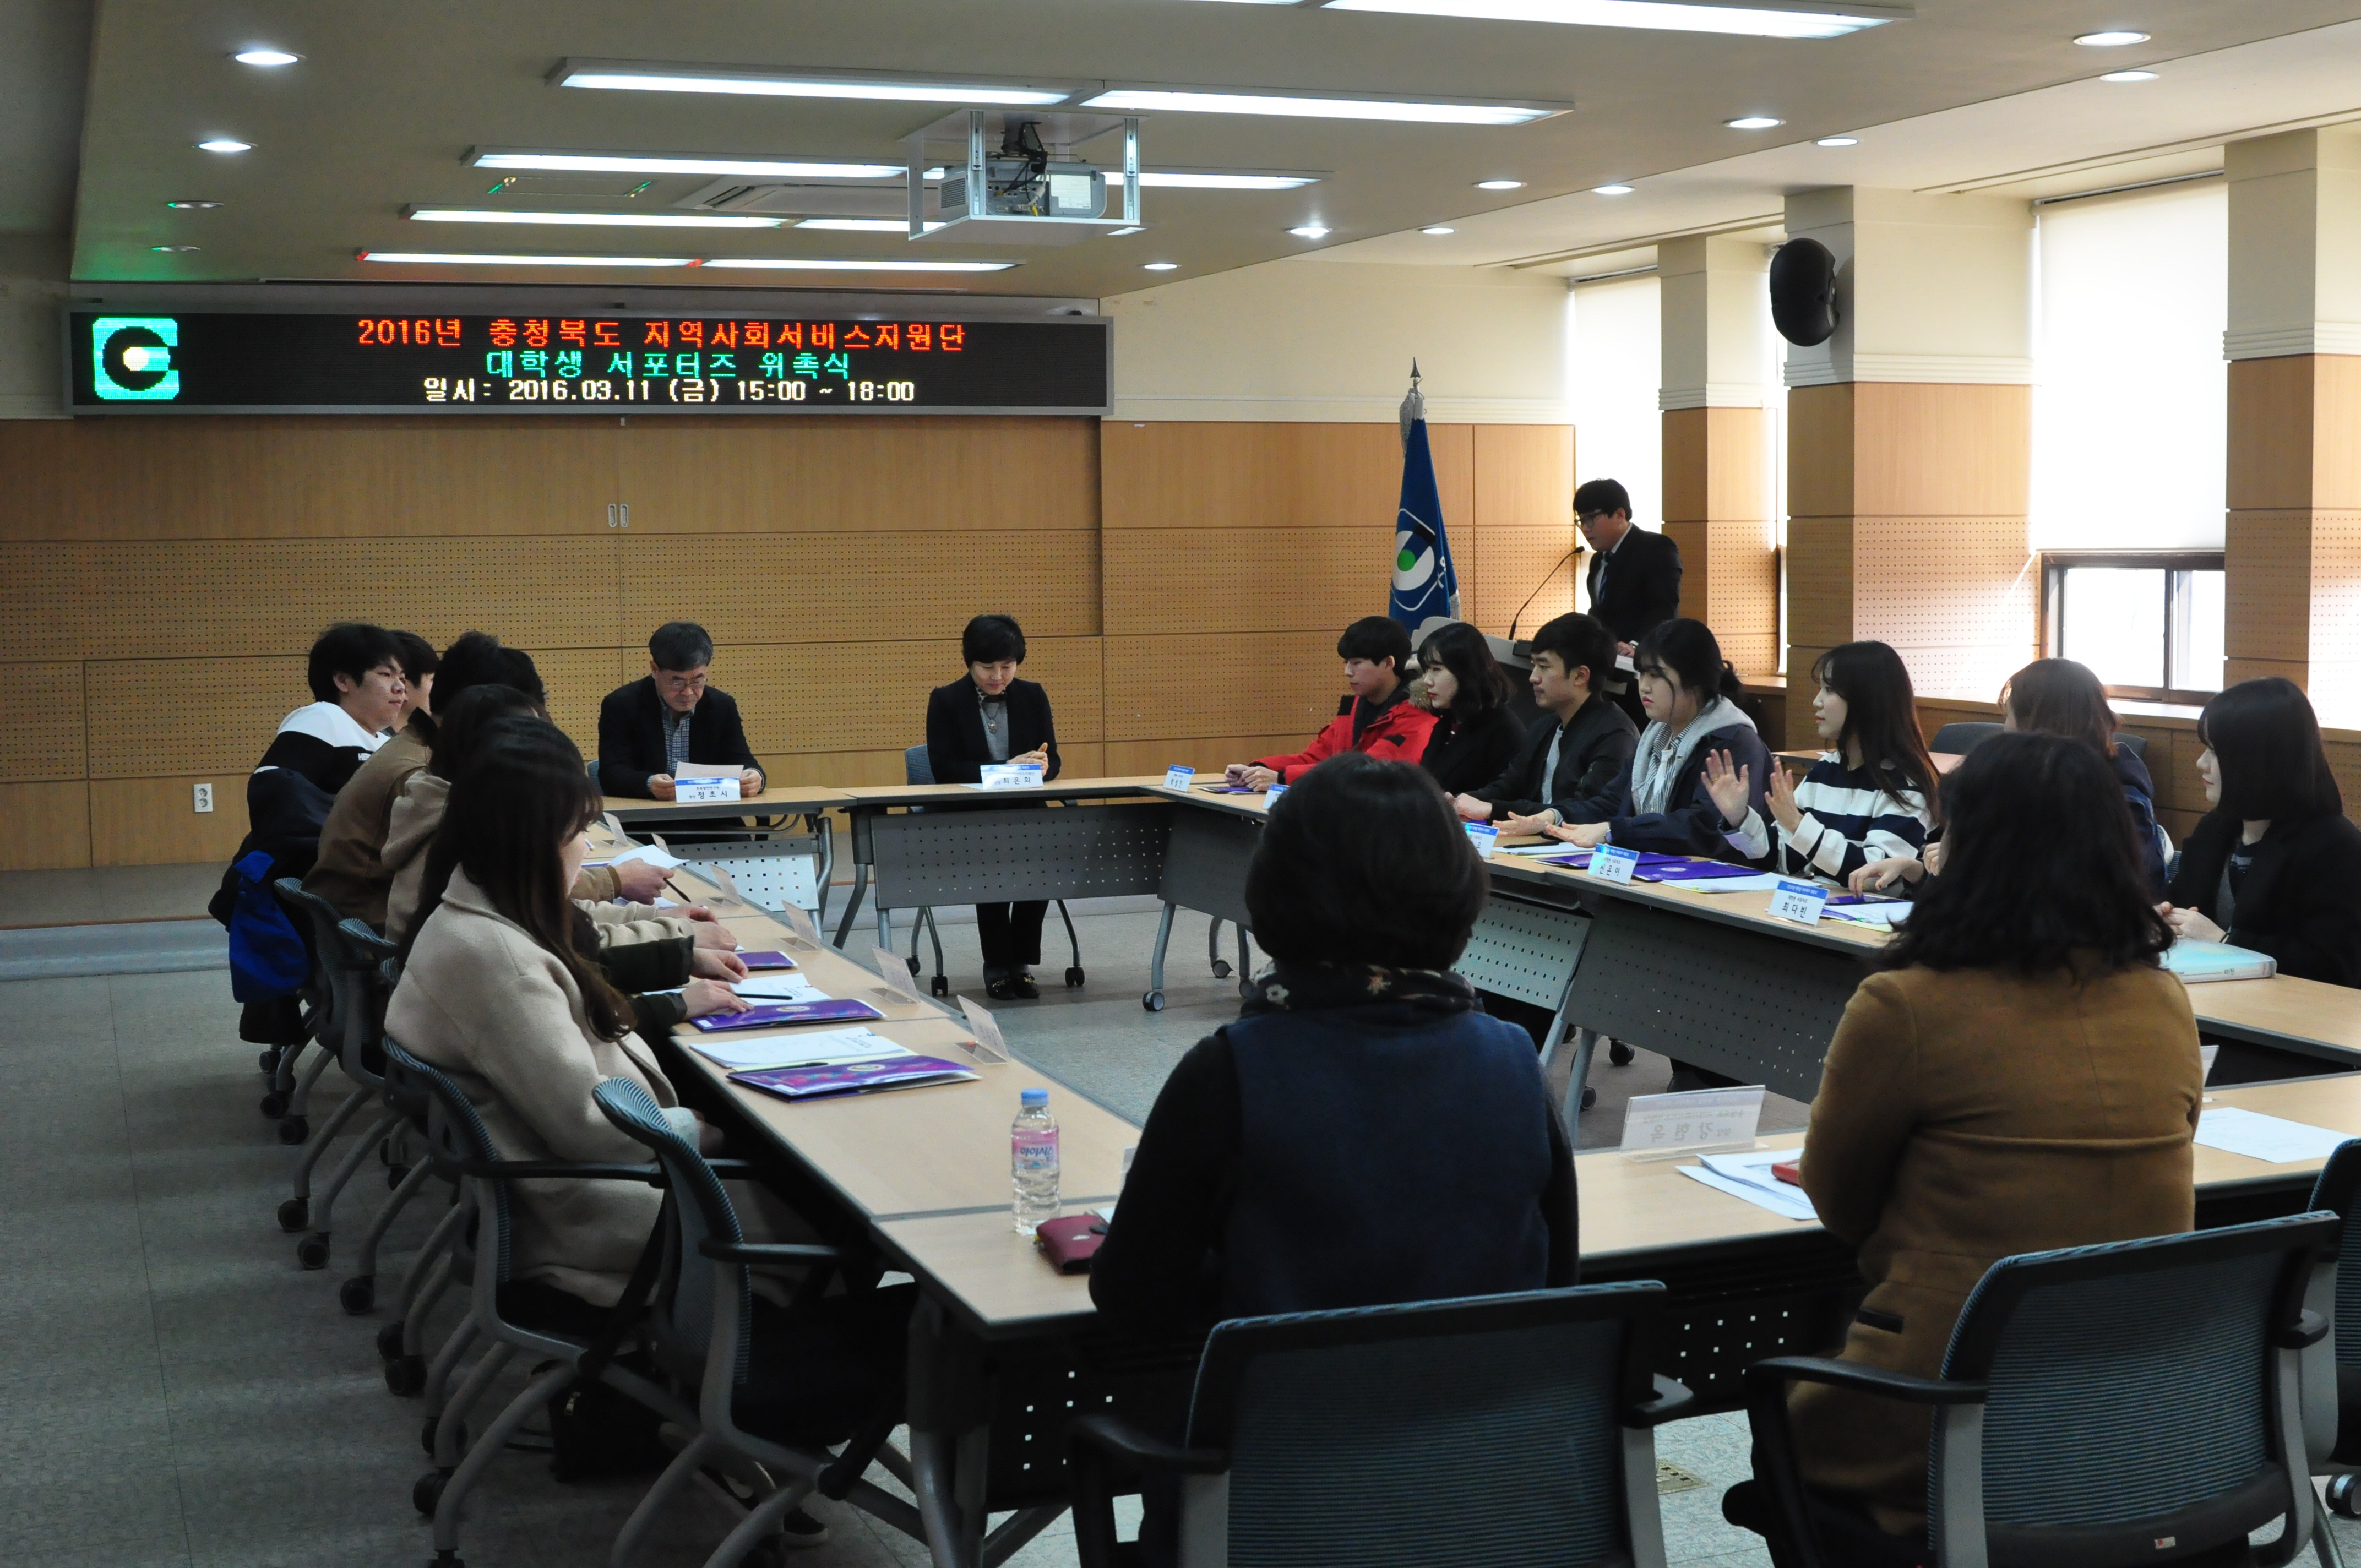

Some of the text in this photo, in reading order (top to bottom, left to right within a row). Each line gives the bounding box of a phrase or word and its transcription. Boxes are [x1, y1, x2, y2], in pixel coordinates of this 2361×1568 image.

[357, 318, 966, 351] 2016년 충청북도 지역사회서비스지원단
[486, 350, 849, 380] 대학생 서포터즈 위촉식
[509, 380, 649, 400] 2016.03.11
[669, 378, 719, 402] (금)
[738, 380, 806, 400] 15:00
[848, 381, 915, 401] 18:00
